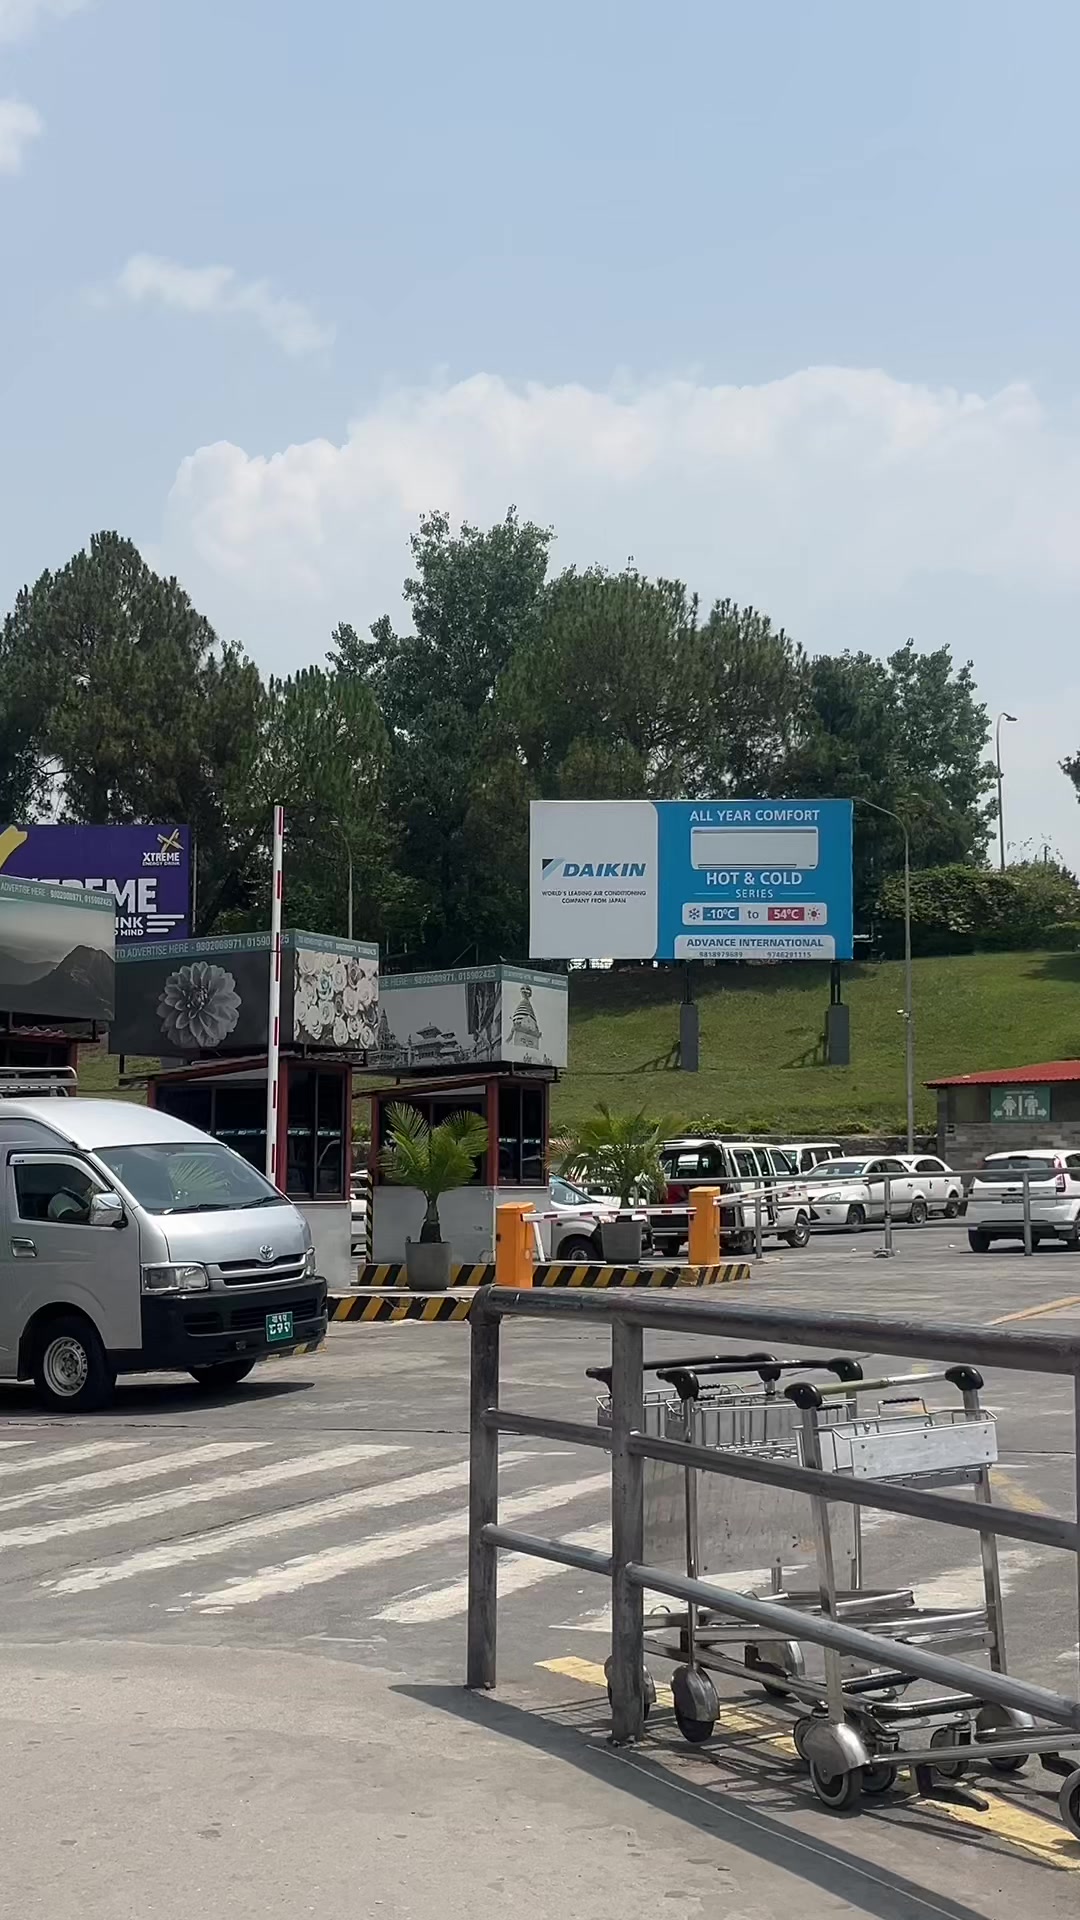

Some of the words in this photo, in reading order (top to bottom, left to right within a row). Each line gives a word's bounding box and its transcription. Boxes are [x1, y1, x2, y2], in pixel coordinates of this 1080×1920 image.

[689, 809, 713, 821] ALL
[717, 809, 751, 821] YEAR
[755, 809, 820, 821] COMFORT
[142, 852, 180, 862] XTREME
[563, 863, 647, 878] DAIKIN
[706, 872, 739, 885] HOT
[744, 872, 755, 885] &
[760, 872, 802, 885] COLD
[735, 889, 774, 898] SERIES
[747, 910, 759, 919] to
[686, 938, 736, 947] ADVANCE
[739, 938, 824, 947] INTERNATIONAL
[126, 944, 168, 958] ADVERTISE
[168, 942, 189, 954] HERE
